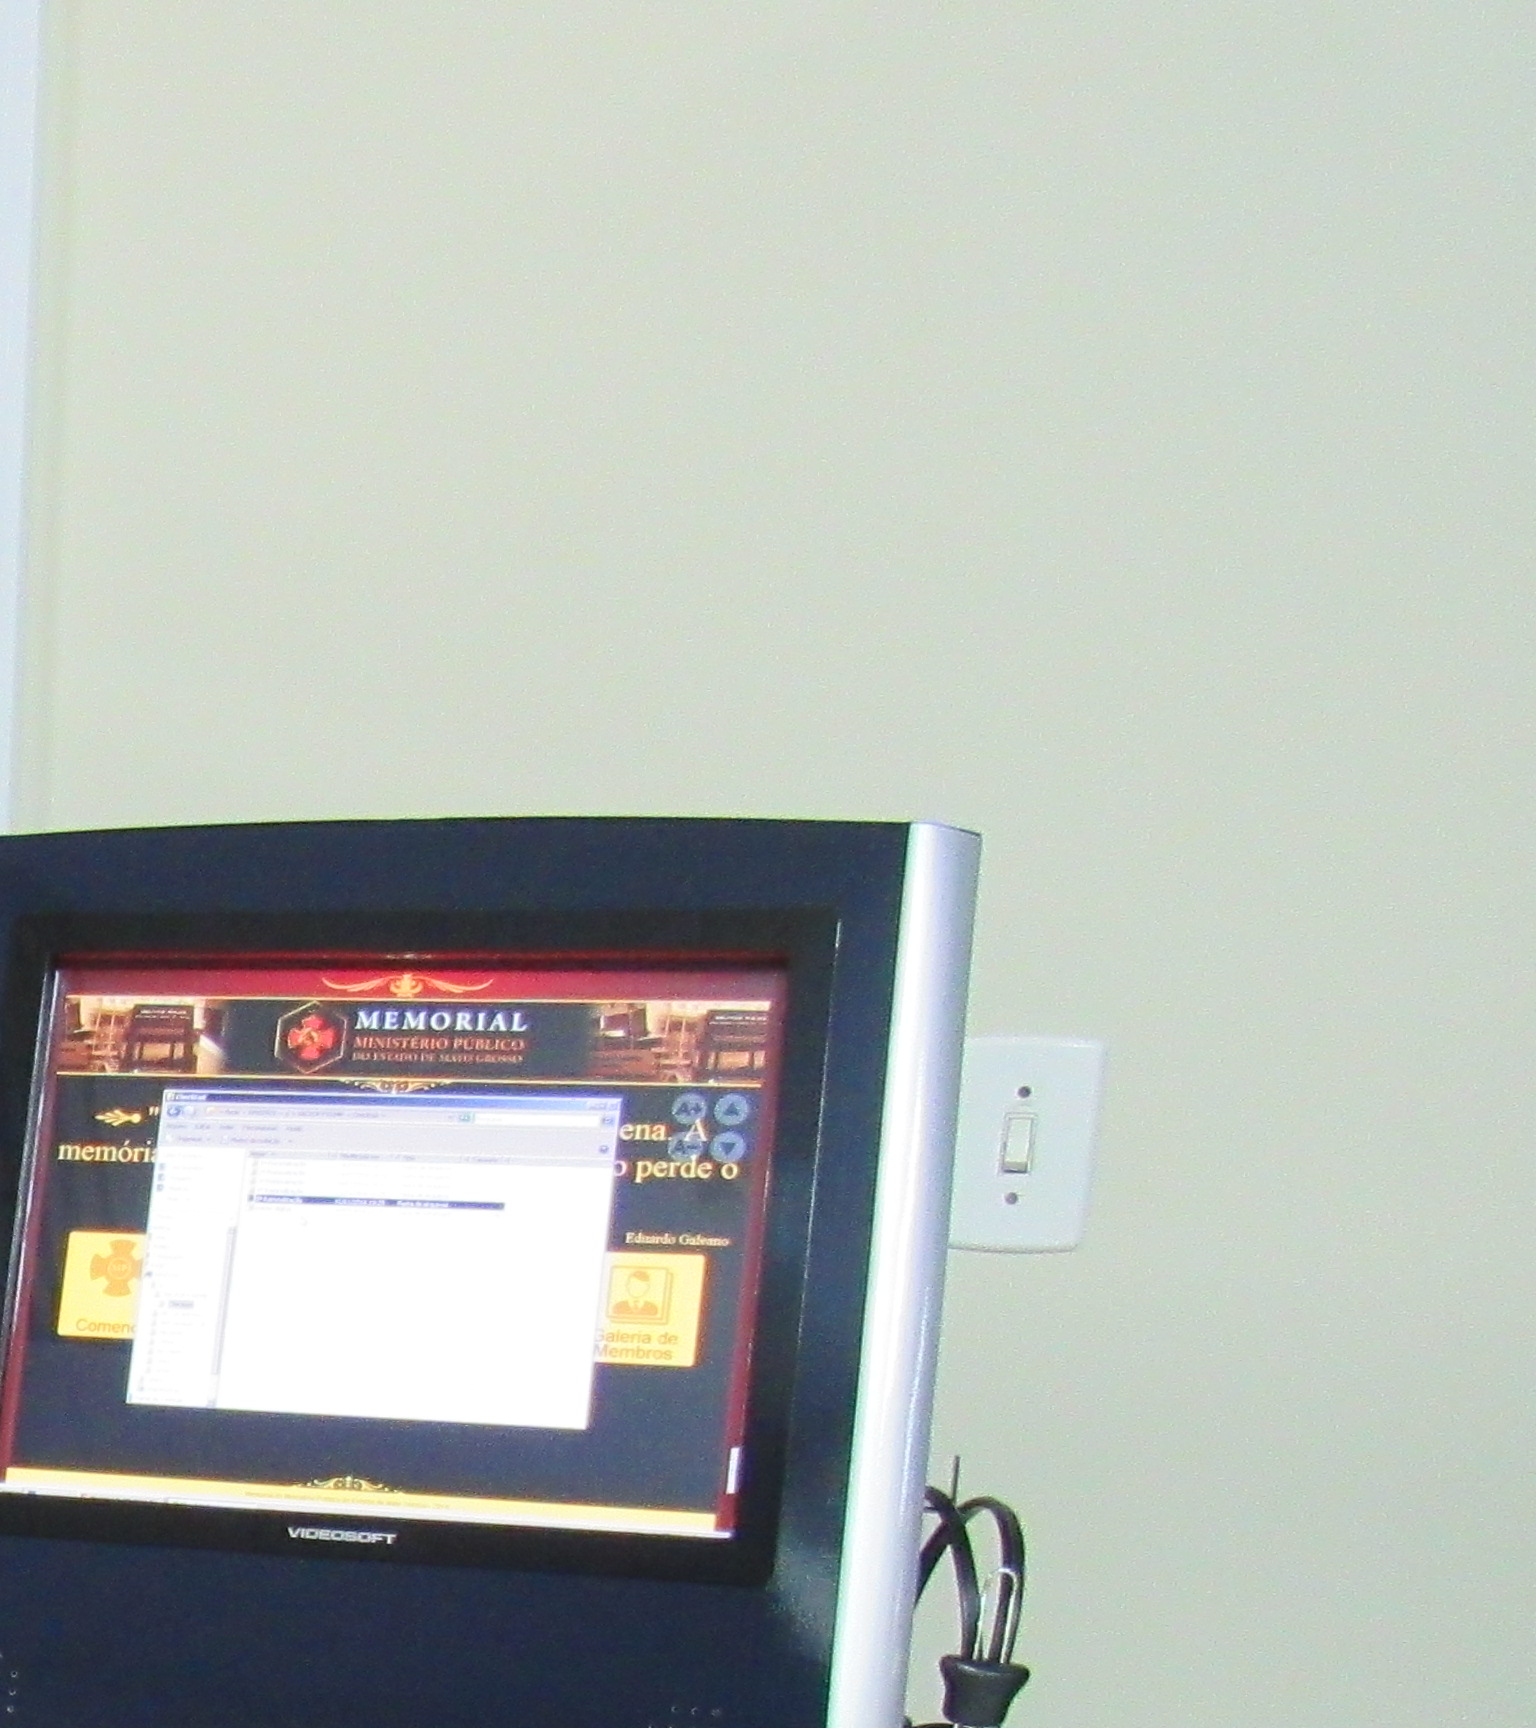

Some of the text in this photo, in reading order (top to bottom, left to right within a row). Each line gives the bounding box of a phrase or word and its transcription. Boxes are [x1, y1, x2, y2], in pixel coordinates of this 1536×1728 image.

[354, 1009, 528, 1033] MEMORIAL
[353, 1034, 526, 1051] MINISTÉRIO PÚBLICO
[684, 1117, 709, 1143] A
[634, 1154, 713, 1184] perde
[720, 1162, 739, 1181] o
[624, 1231, 677, 1246] Eduardo
[656, 1331, 679, 1345] de
[594, 1343, 674, 1361] Membros
[287, 1526, 399, 1545] VIDEOSOFT
